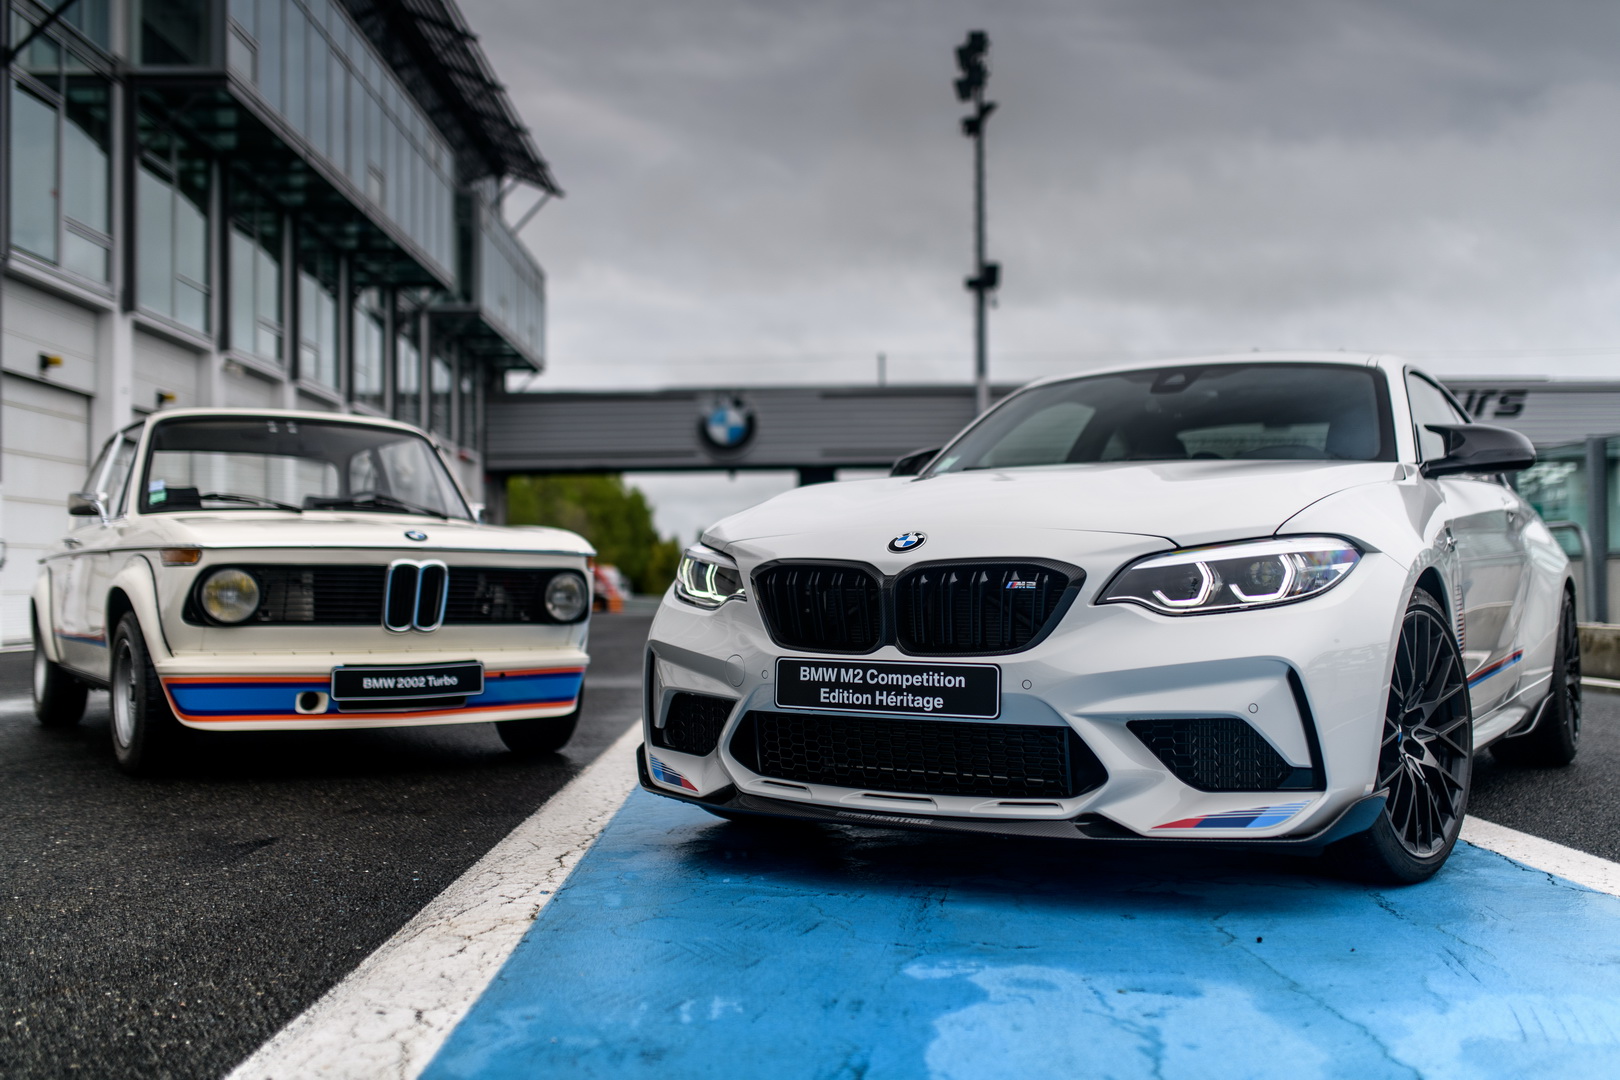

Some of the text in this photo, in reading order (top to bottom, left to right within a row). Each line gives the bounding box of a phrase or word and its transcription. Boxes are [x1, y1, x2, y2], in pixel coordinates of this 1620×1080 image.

[362, 674, 458, 689] BMW 2002 Turbo
[800, 666, 966, 688] BMW M2 Competition
[820, 687, 944, 711] Edition Héritage
